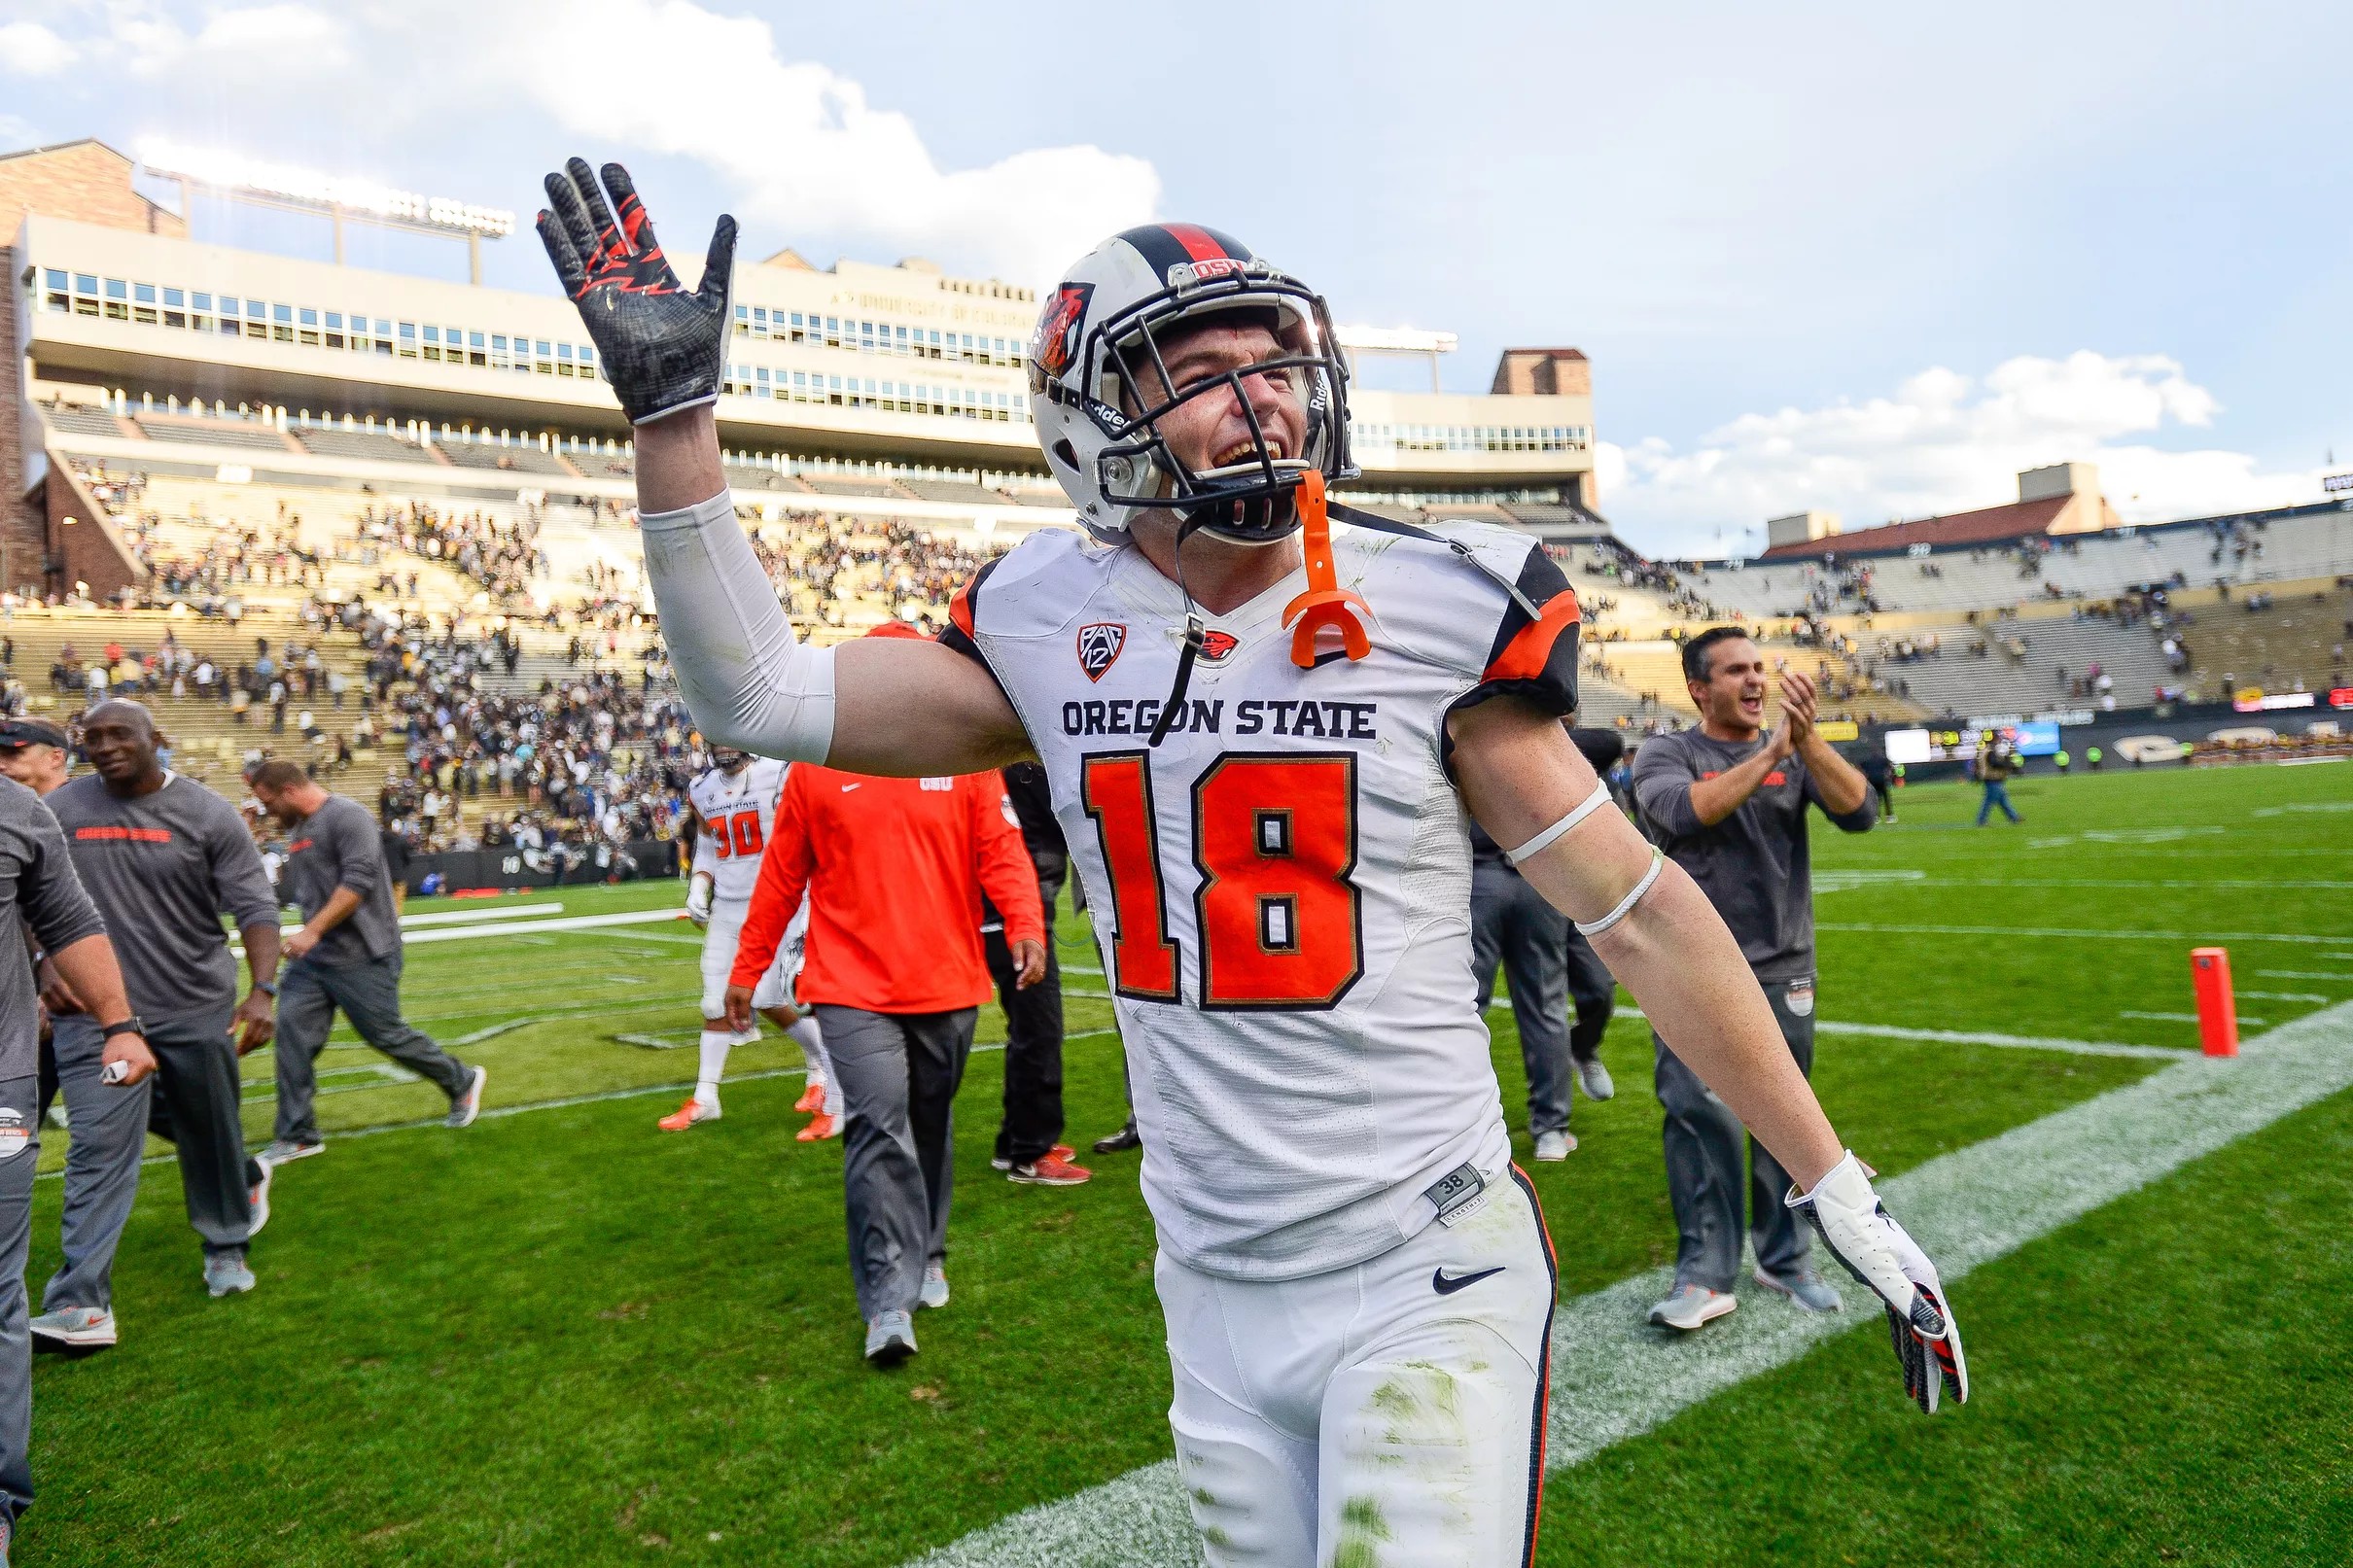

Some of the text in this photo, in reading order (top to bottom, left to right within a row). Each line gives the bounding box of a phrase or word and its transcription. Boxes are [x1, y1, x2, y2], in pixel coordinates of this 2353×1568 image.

[1194, 260, 1245, 278] OSU
[1080, 625, 1122, 659] PAC
[1086, 647, 1108, 669] 12
[1236, 700, 1377, 740] STATE
[1079, 749, 1365, 1011] 18
[1439, 1174, 1464, 1195] 38
